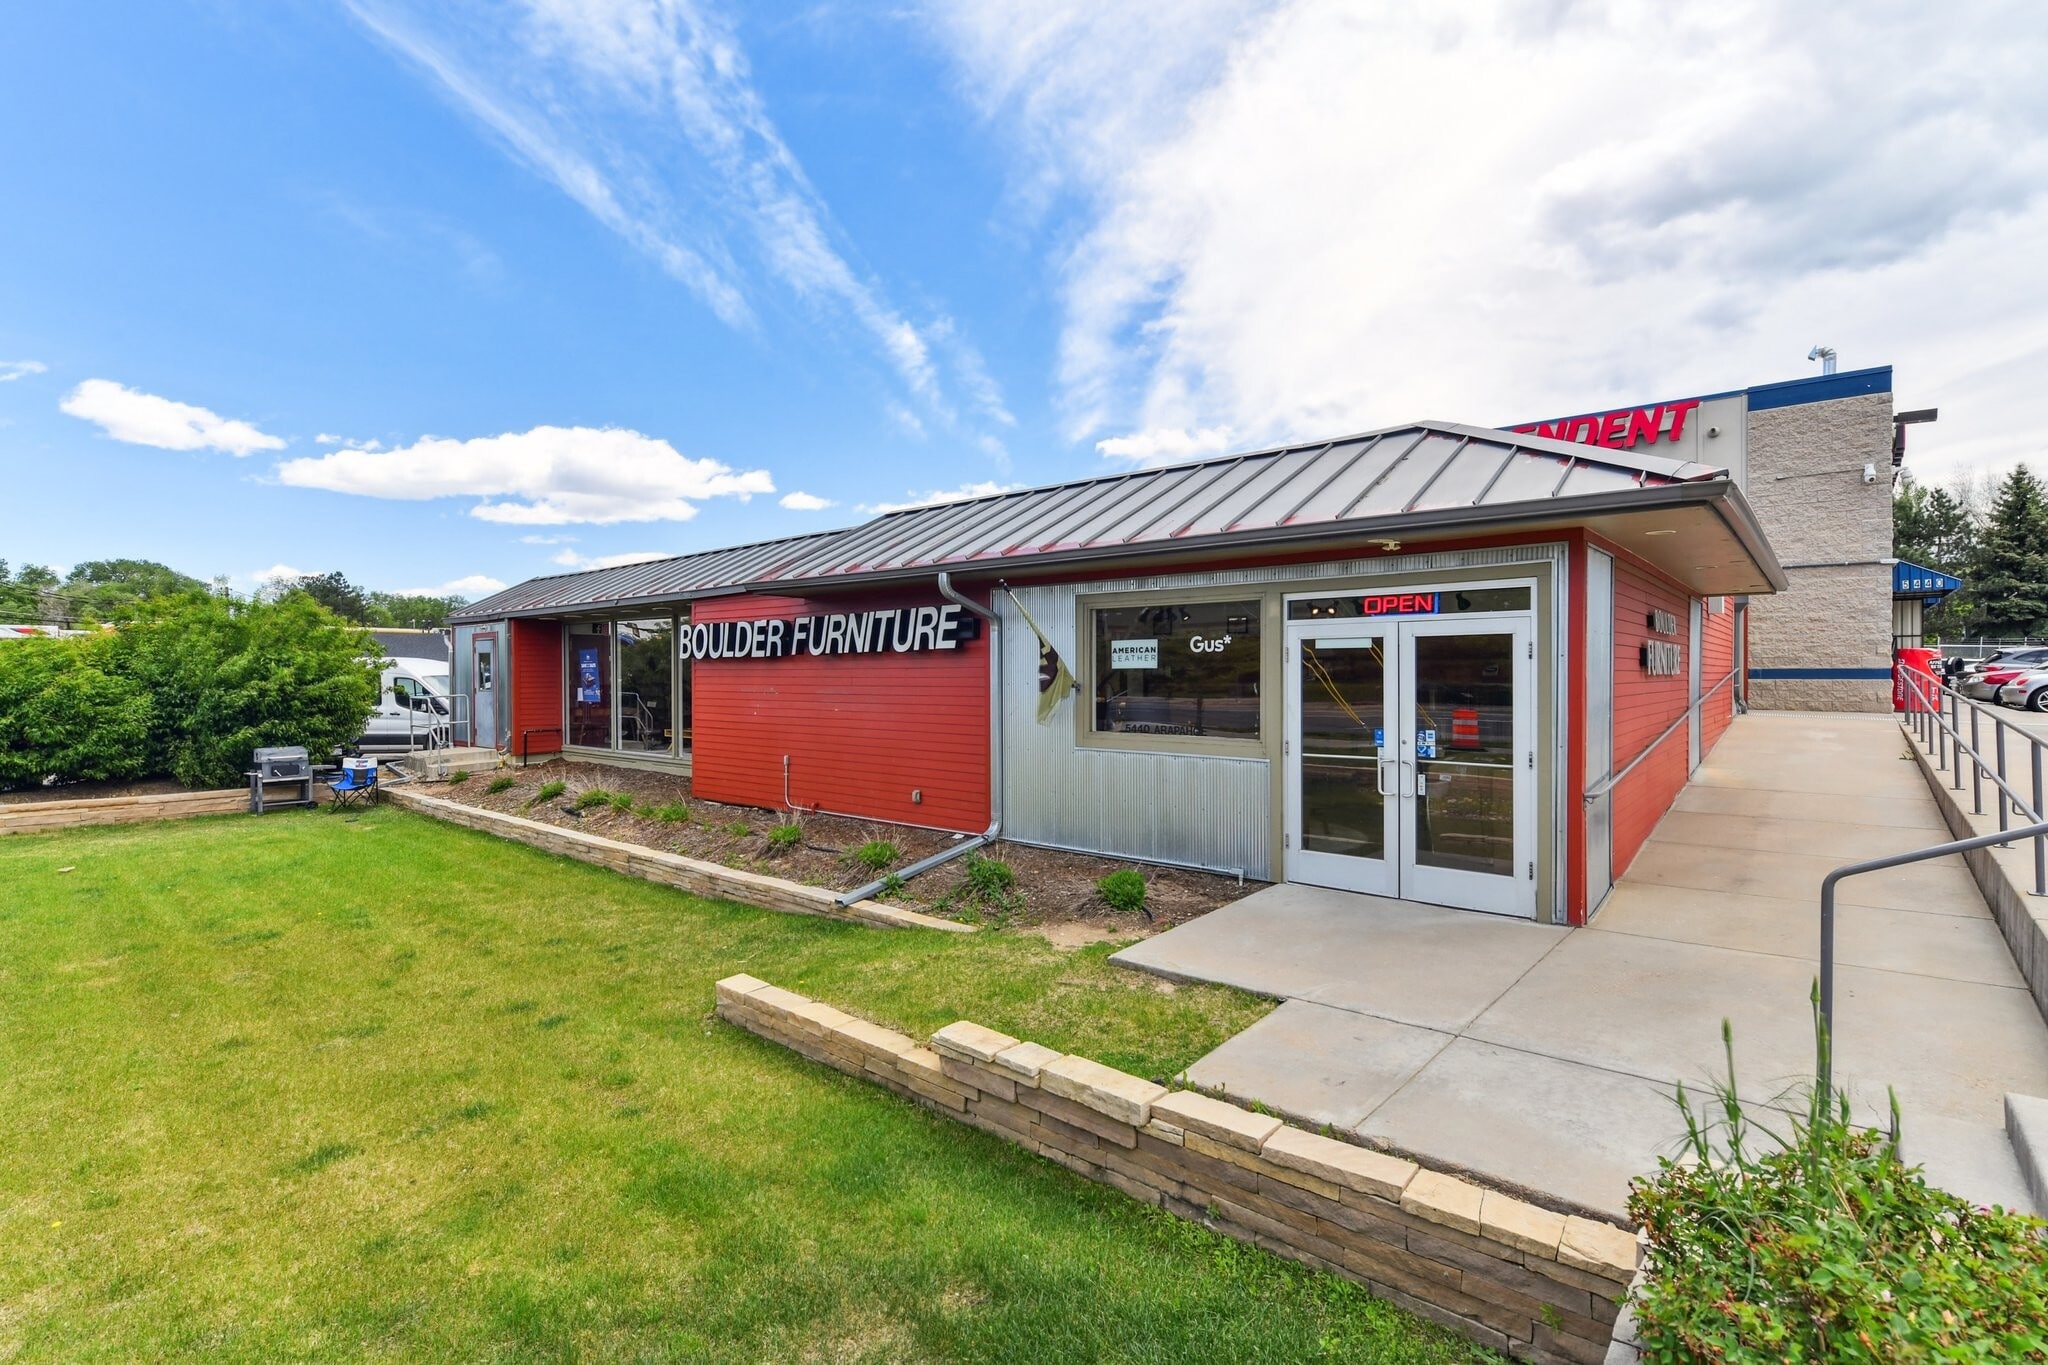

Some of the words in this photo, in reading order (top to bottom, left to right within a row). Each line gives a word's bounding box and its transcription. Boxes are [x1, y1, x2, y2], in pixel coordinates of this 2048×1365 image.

[1512, 400, 1699, 449] NDENT
[1364, 593, 1432, 614] OPEN
[680, 619, 784, 659] BOULDER
[791, 604, 962, 656] FURNITURE
[1648, 639, 1680, 675] FURNITURE
[1125, 724, 1150, 733] 5440
[1154, 725, 1207, 736] ARAPAHOE
